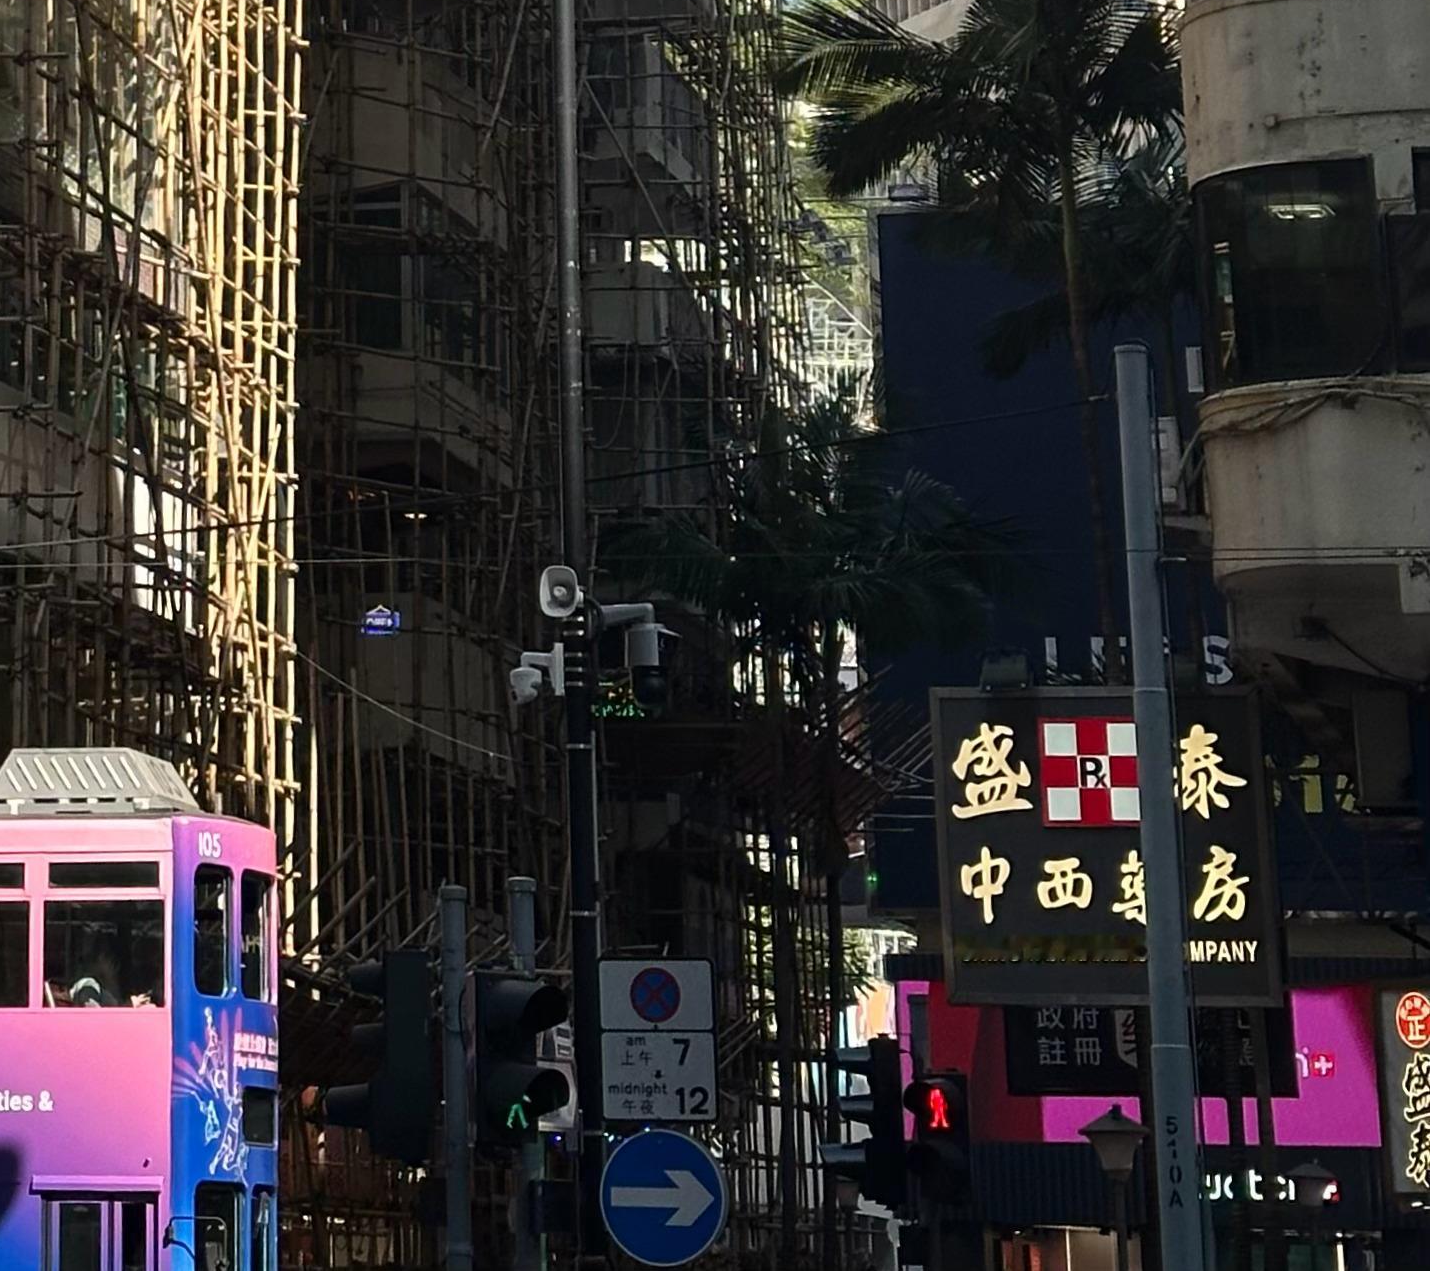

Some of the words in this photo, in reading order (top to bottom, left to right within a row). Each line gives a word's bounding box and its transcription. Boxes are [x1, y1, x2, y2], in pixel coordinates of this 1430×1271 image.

[952, 722, 1034, 820] 盛
[1172, 723, 1248, 820] 泰
[198, 832, 222, 857] 105
[1037, 1007, 1099, 1030] 政府
[625, 1037, 646, 1046] am
[672, 1038, 690, 1066] 7
[1037, 1037, 1102, 1066] 註冊
[621, 1050, 652, 1066] 上午
[38, 1090, 54, 1112] &
[608, 1083, 668, 1097] midnight
[675, 1086, 709, 1115] 12
